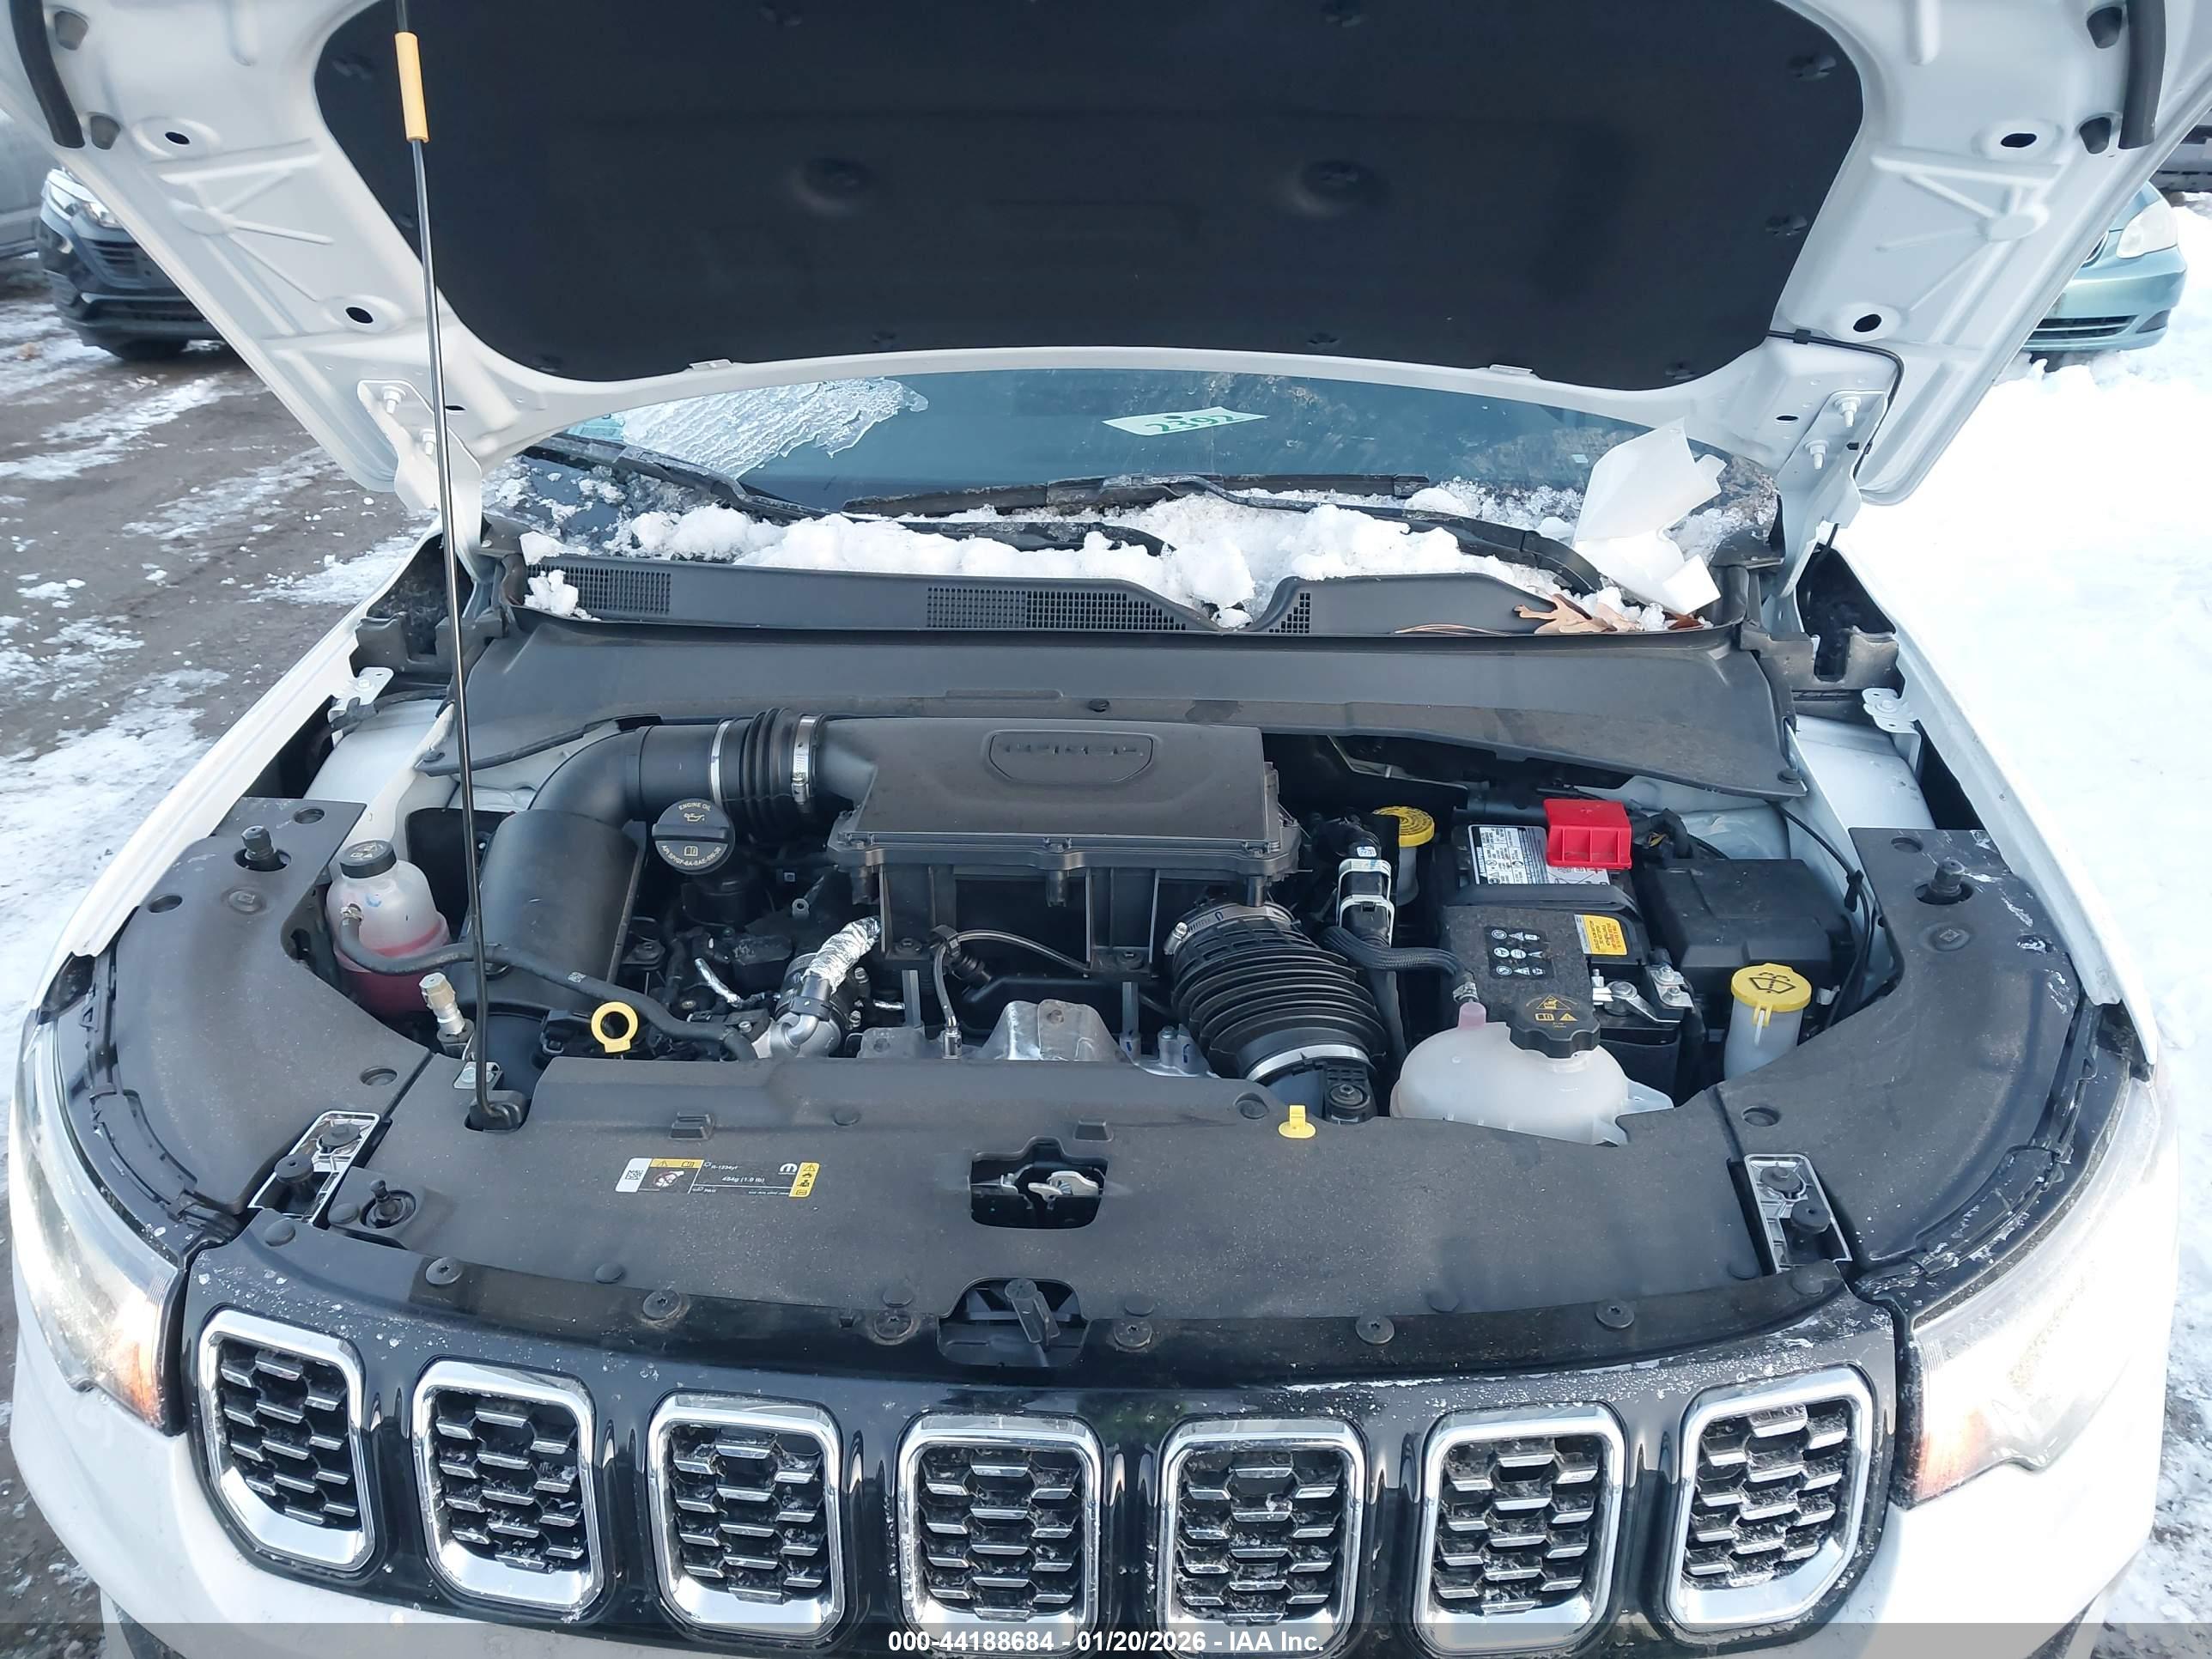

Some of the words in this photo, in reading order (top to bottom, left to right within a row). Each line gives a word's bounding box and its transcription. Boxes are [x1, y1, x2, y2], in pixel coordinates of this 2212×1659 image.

[1145, 415, 1244, 431] 2392
[678, 802, 701, 811] ENGINE
[702, 803, 711, 811] OIL
